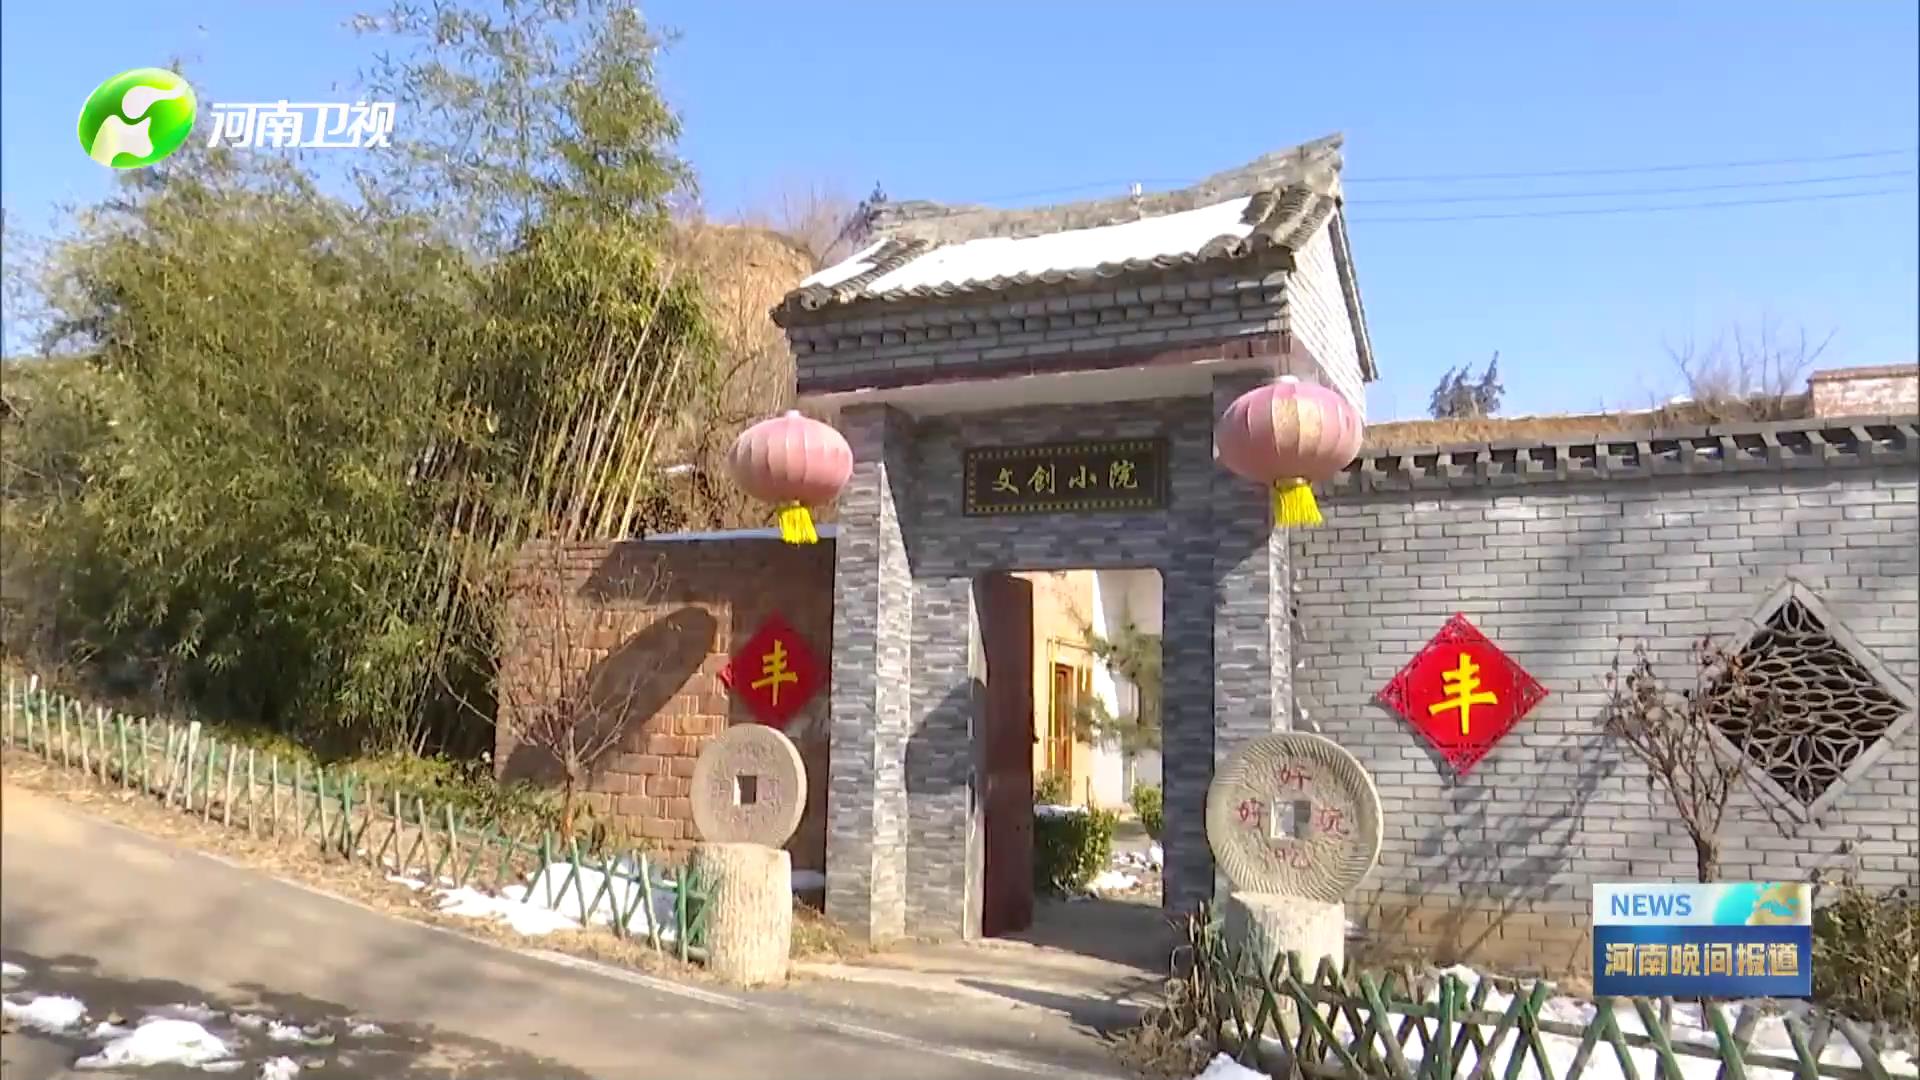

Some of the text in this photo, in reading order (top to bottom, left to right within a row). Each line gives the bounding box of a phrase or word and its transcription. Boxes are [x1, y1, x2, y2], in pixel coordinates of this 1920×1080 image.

[991, 459, 1138, 496] 文创小院
[751, 639, 798, 707] 丰
[1428, 652, 1498, 736] 丰
